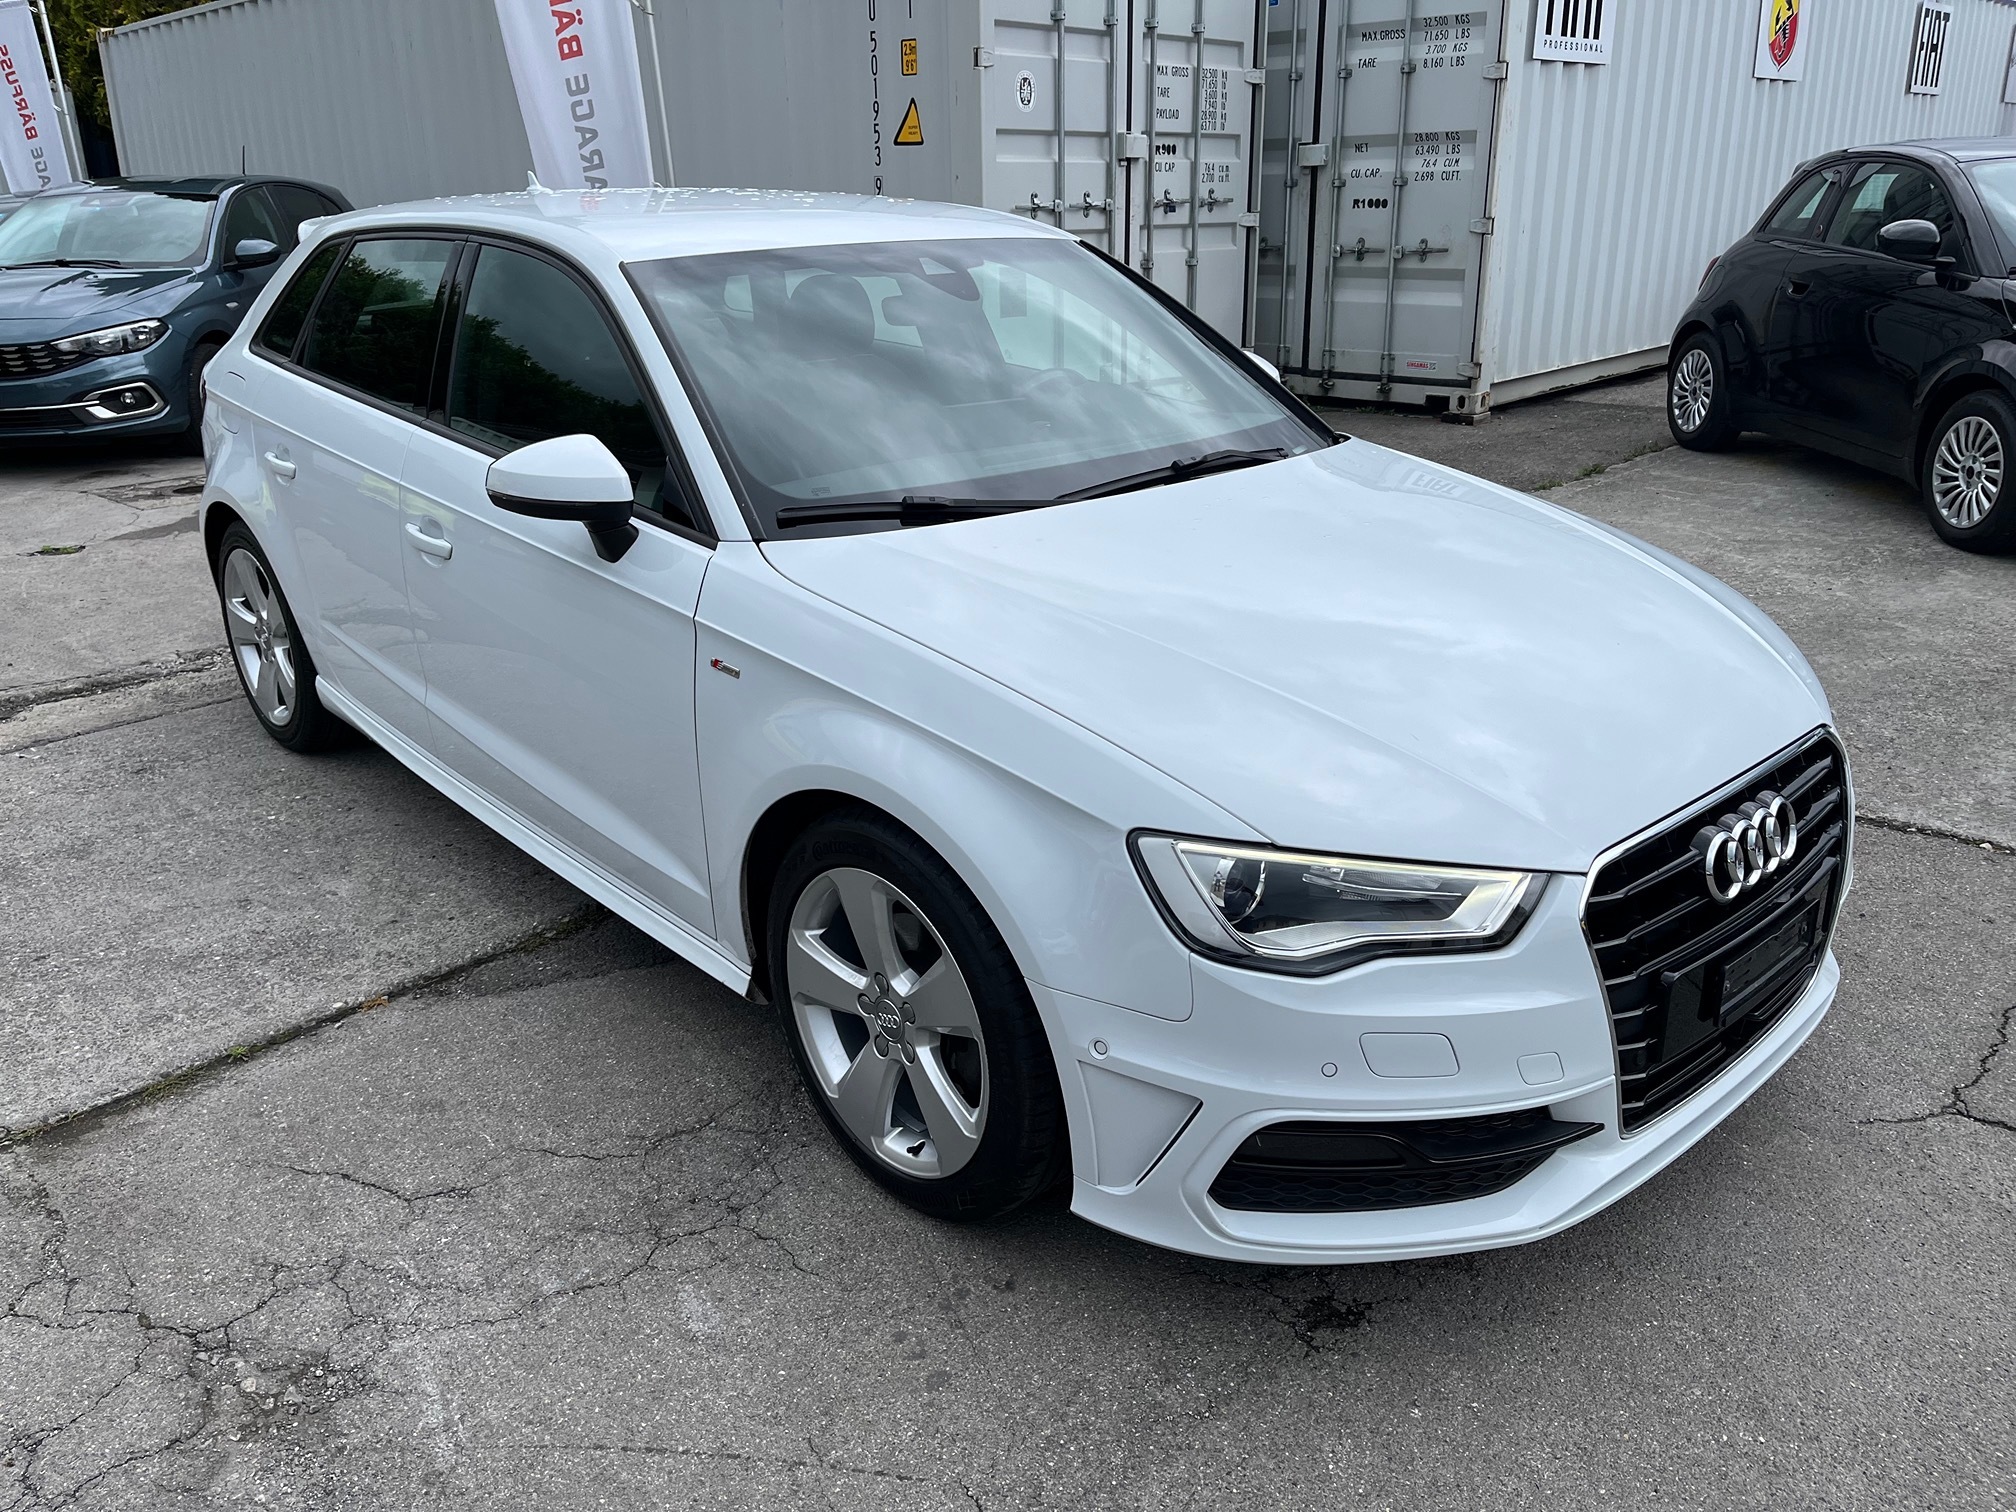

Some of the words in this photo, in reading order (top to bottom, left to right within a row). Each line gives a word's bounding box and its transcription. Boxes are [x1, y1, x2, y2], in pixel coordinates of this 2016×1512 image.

[1423, 15, 1449, 28] 32.500
[1455, 13, 1471, 25] KGS
[1424, 29, 1449, 42] 71.650
[1455, 27, 1471, 40] LBS
[1425, 44, 1447, 55] 3.700
[1452, 42, 1468, 53] KGS
[1543, 39, 1603, 53] PROFESSIONAL
[1914, 8, 1950, 88] FIAT
[1358, 57, 1378, 69] TARE
[1422, 57, 1444, 69] 8.160
[1450, 55, 1466, 67] LBS
[1156, 65, 1169, 76] MAX
[1171, 66, 1190, 78] GROSS
[1221, 69, 1228, 82] kg
[1221, 80, 1227, 90] lb
[1157, 86, 1171, 98] TARE
[1221, 90, 1228, 102] kg
[1221, 100, 1226, 111] lb
[1156, 108, 1180, 120] PAYLOAD
[1220, 111, 1227, 123] kg
[1220, 121, 1225, 131] lb
[1414, 131, 1440, 143] 28.800
[1445, 131, 1461, 141] KGS
[1155, 143, 1177, 156] R900
[1354, 142, 1369, 153] NET
[1414, 144, 1440, 156] 63.490
[1445, 144, 1461, 154] LBS
[1421, 158, 1438, 168] 76.4
[1364, 168, 1382, 178] CAP.
[1414, 171, 1435, 182] 2.698
[1352, 198, 1388, 209] R1000
